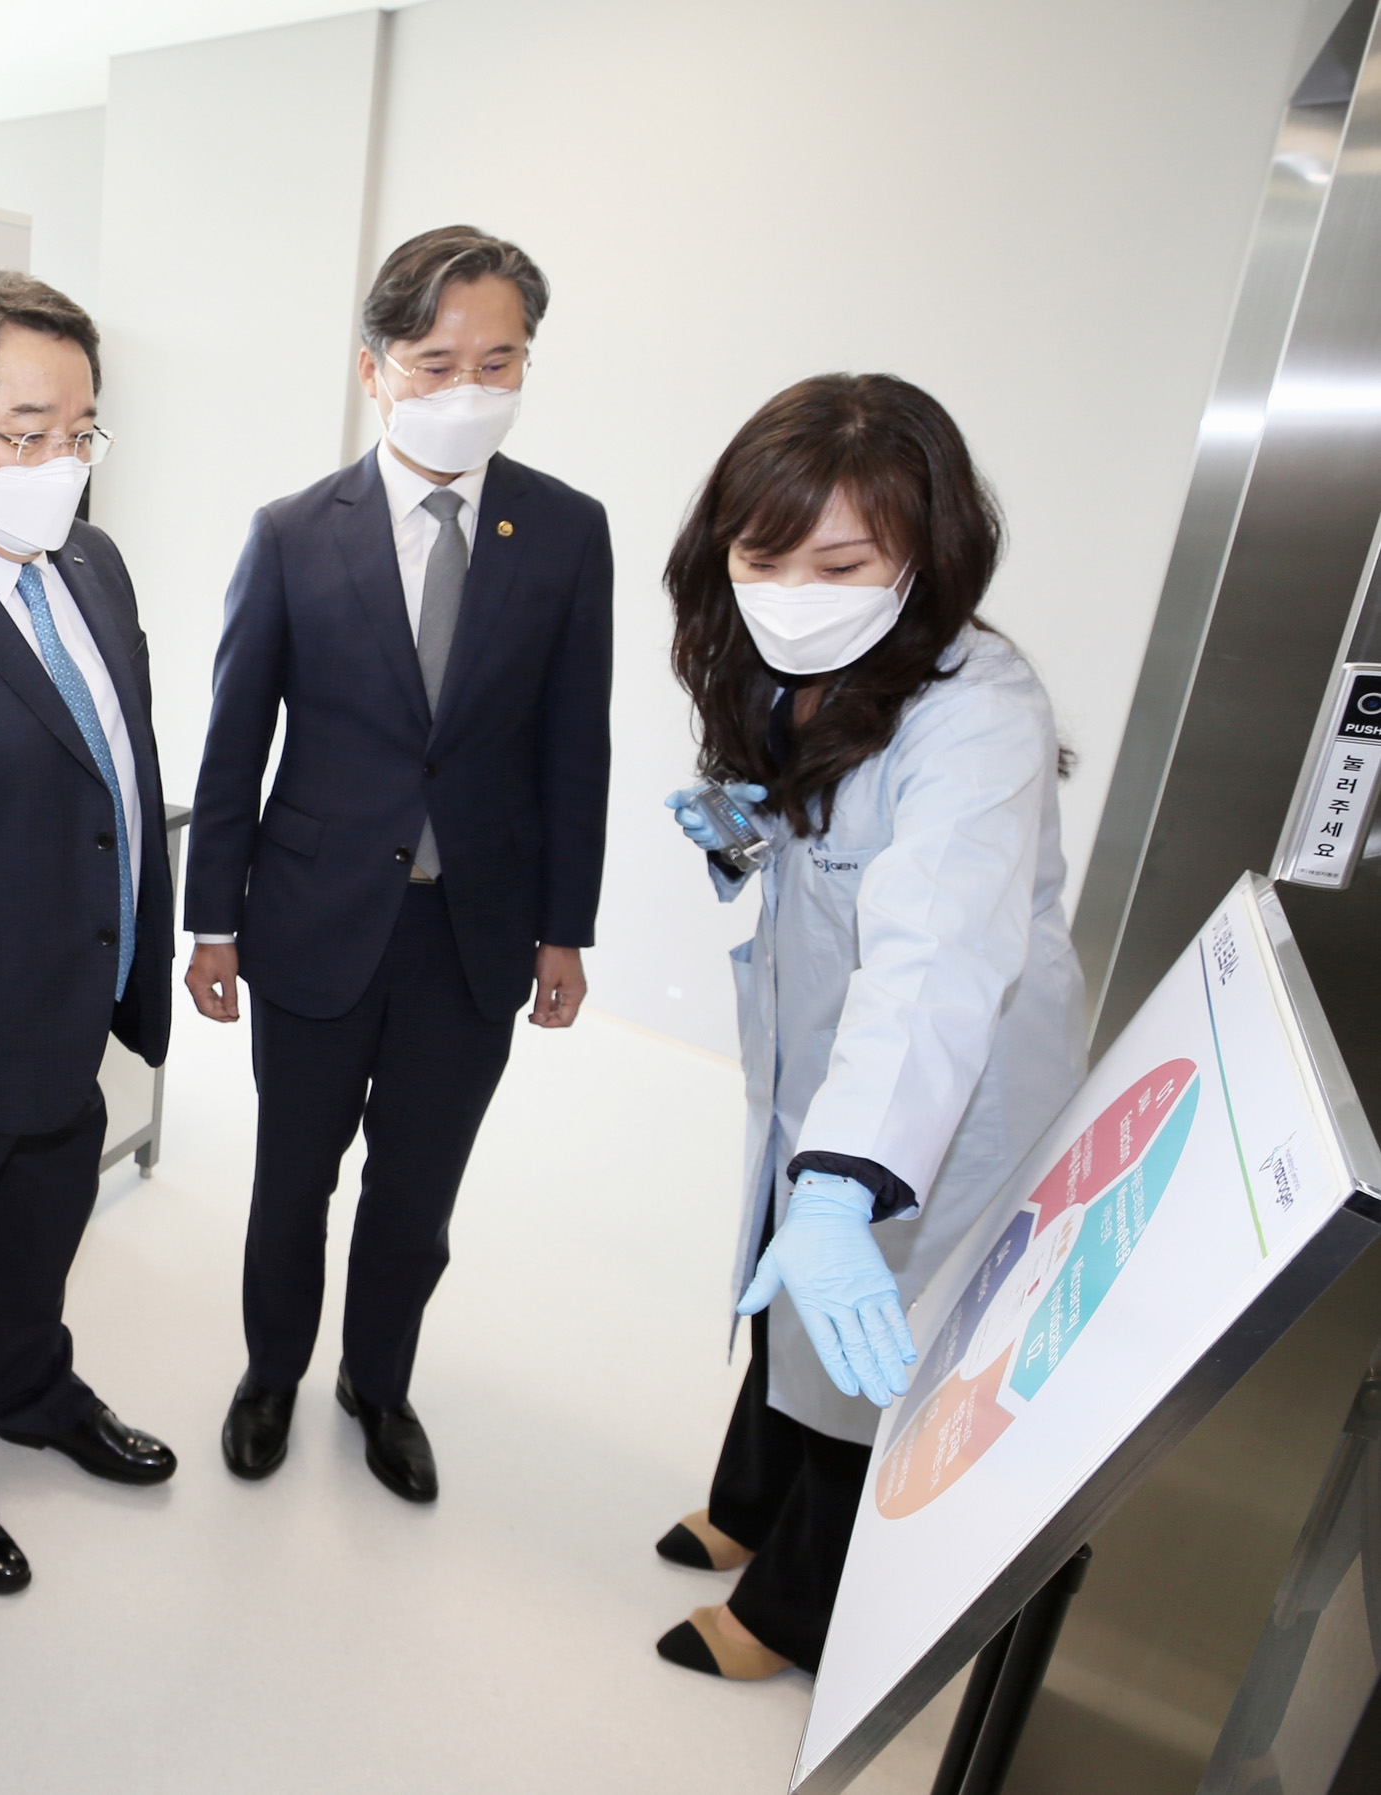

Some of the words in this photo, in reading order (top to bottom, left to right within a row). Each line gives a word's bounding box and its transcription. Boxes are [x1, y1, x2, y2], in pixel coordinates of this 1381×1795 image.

[1345, 723, 1381, 736] PUSH
[1313, 754, 1365, 858] 눌러주세요
[1216, 938, 1240, 987] 프로세스
[1155, 1076, 1175, 1111] 01
[1119, 1109, 1133, 1165] Extraction
[1270, 1156, 1294, 1213] macrogen
[1115, 1236, 1131, 1269] 반응
[1066, 1255, 1083, 1335] Microarray
[1025, 1330, 1044, 1370] 02
[1044, 1278, 1065, 1375] Hybridization
